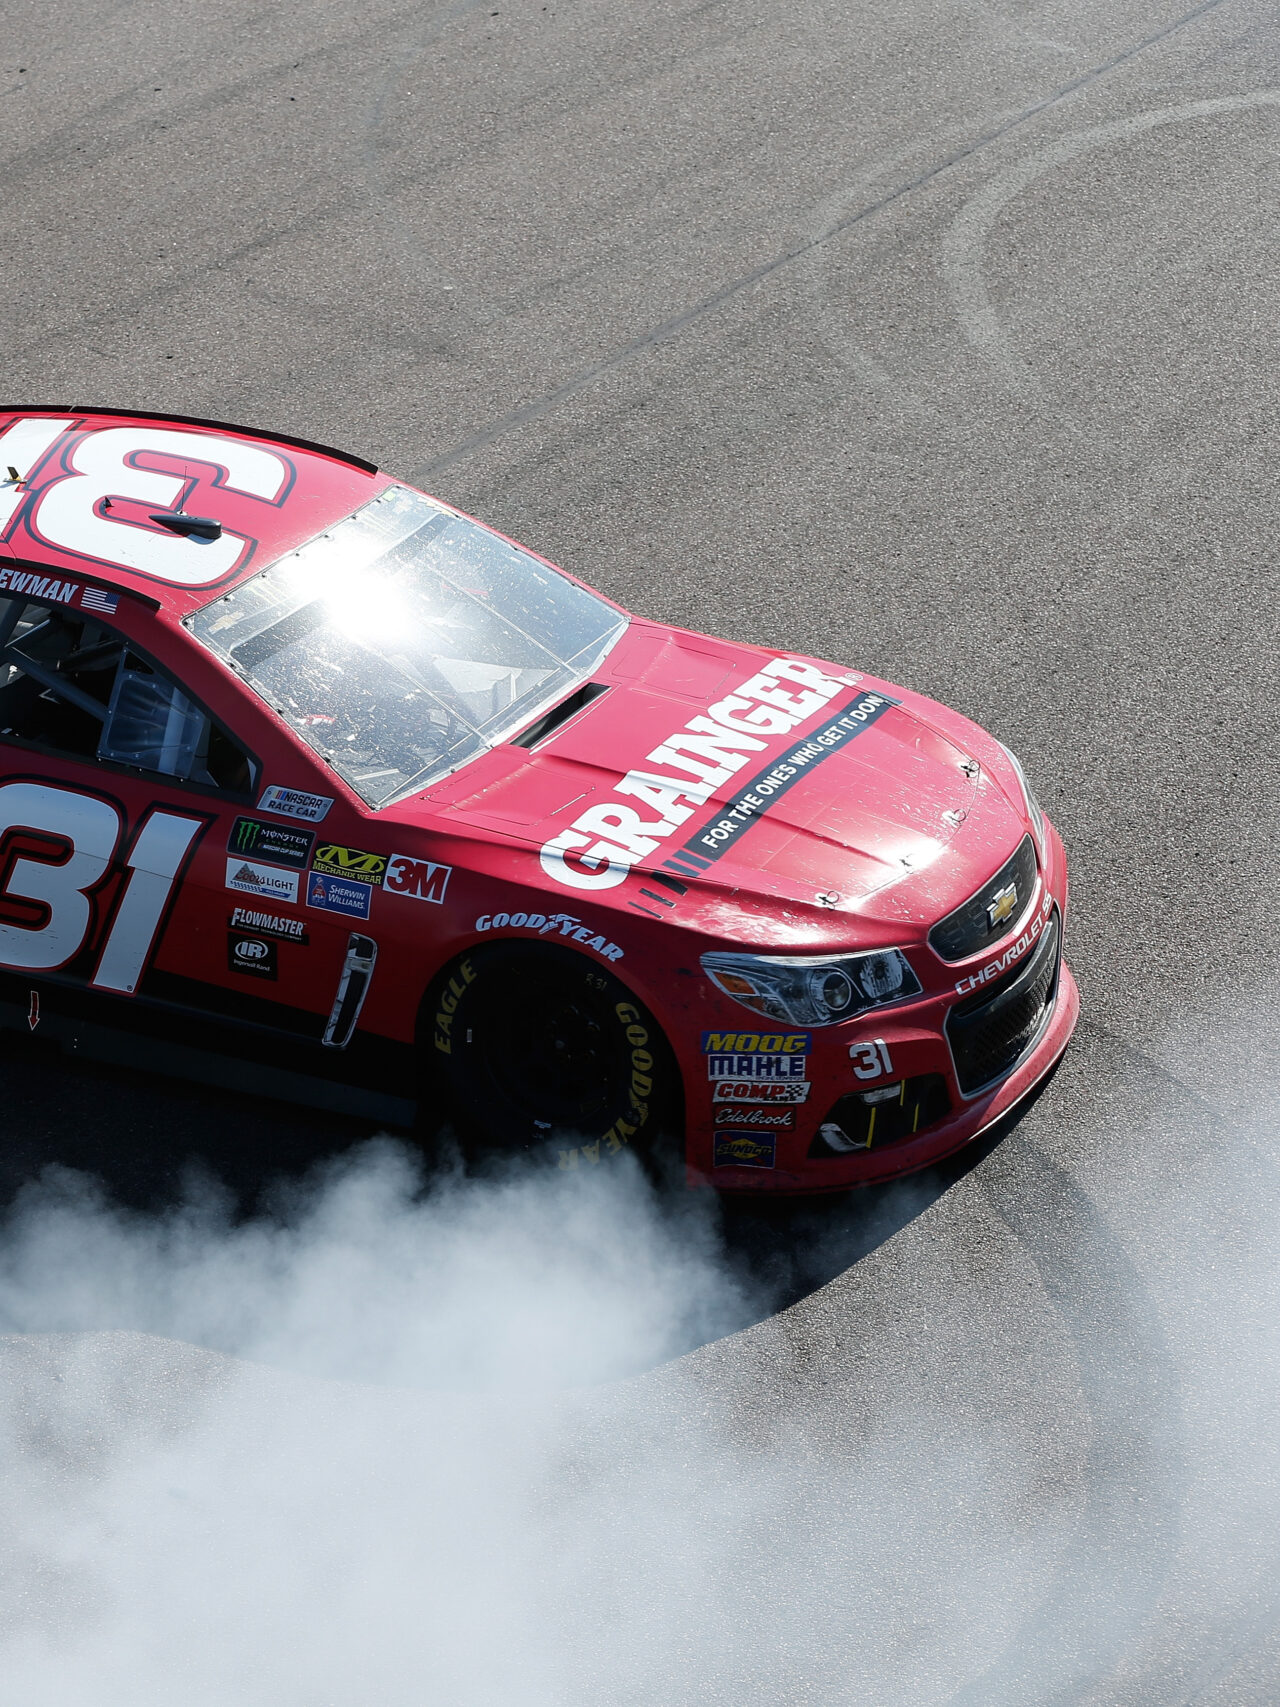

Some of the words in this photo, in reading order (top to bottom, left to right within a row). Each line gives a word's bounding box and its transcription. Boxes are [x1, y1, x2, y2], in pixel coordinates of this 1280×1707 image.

[539, 657, 858, 891] GRAINGER
[701, 820, 739, 849] FOR
[728, 794, 764, 821] THE
[755, 764, 797, 795] ONES
[787, 743, 824, 766] WHO
[816, 726, 847, 746] GET
[838, 717, 858, 730] IT
[849, 694, 888, 721] DON
[268, 800, 294, 813] RACE
[296, 807, 317, 818] CAR
[284, 791, 323, 809] NASCAR
[261, 829, 308, 846] MONSTER
[313, 860, 356, 879] MECHANIX
[357, 873, 382, 885] WEAR
[387, 858, 449, 902] 3M
[266, 878, 294, 891] LIGHT
[329, 885, 365, 900] SHERWIN
[231, 907, 304, 936] FLOWMASTER
[475, 912, 624, 962] GOODYEAR
[955, 912, 1043, 995] CHEVROLET
[1042, 889, 1052, 916] SS
[240, 941, 263, 958] IR
[435, 959, 478, 1054] EAGLE
[705, 1034, 808, 1053] MOOG
[710, 1055, 804, 1076] MAHLE
[849, 1038, 893, 1080] 31
[717, 1083, 786, 1098] COMP
[715, 1108, 793, 1126] Edelbrock
[718, 1144, 772, 1157] SUNOCO
